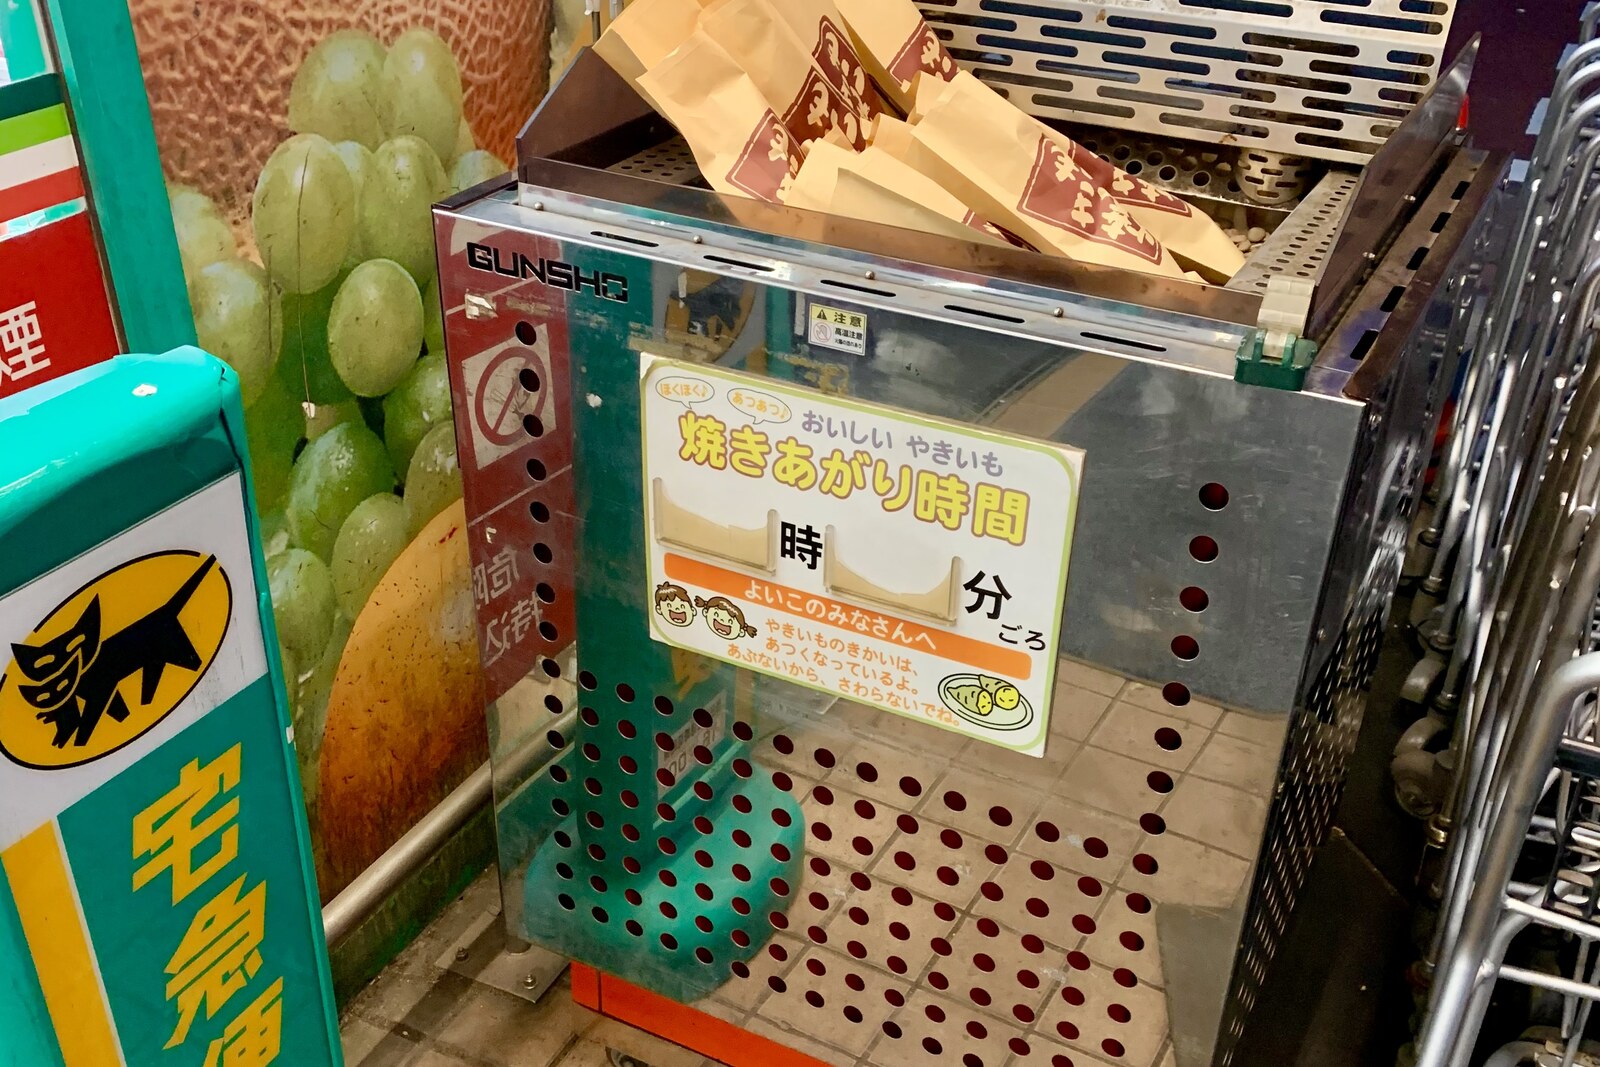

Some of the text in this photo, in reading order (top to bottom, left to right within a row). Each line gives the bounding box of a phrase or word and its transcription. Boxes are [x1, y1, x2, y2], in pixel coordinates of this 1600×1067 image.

[467, 242, 628, 303] GUNSHO
[834, 312, 862, 327] 注意
[801, 410, 1003, 477] おいしい やきいも
[677, 410, 1031, 546] 焼きあがり時間
[780, 520, 824, 570] 時
[744, 579, 937, 651] よいこのみなさんへ
[765, 617, 918, 677] やきいものきかいは、
[765, 636, 920, 696] あつくなっているよ。
